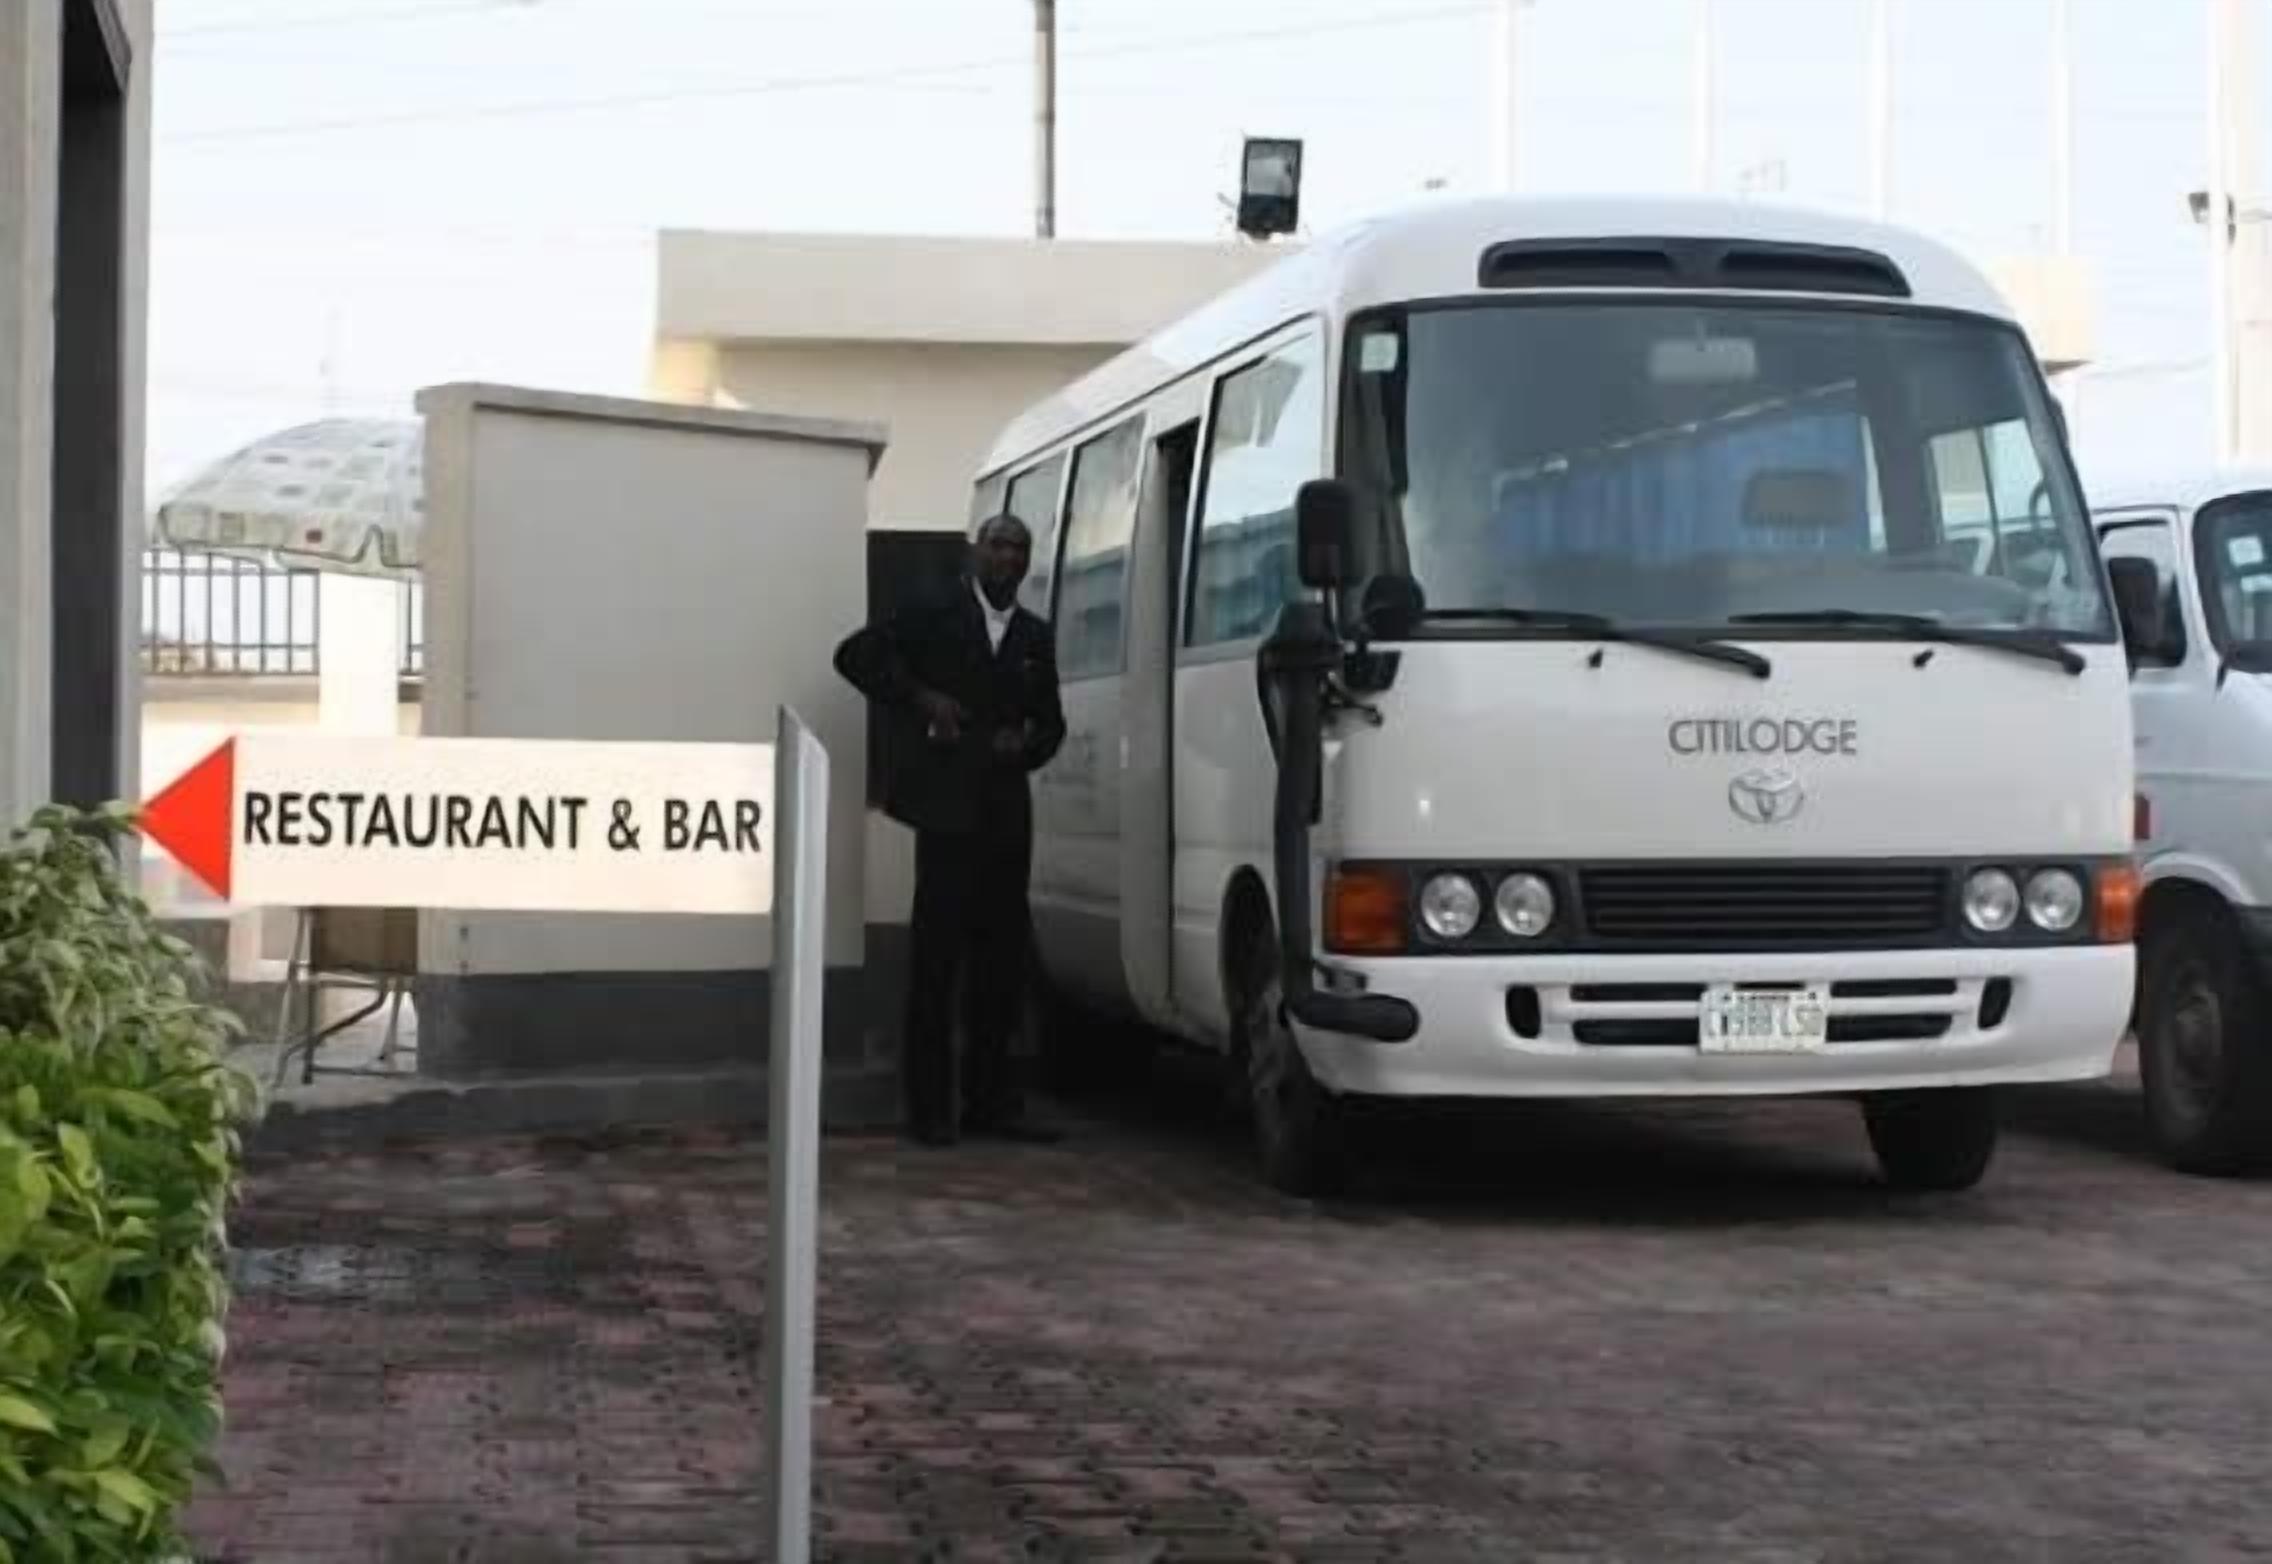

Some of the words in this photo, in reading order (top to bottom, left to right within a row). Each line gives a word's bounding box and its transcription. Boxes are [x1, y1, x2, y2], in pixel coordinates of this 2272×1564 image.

[1668, 717, 1857, 755] CITILODGE
[243, 791, 588, 851] RESTAURANT
[606, 799, 640, 852] &
[663, 799, 763, 853] BAR
